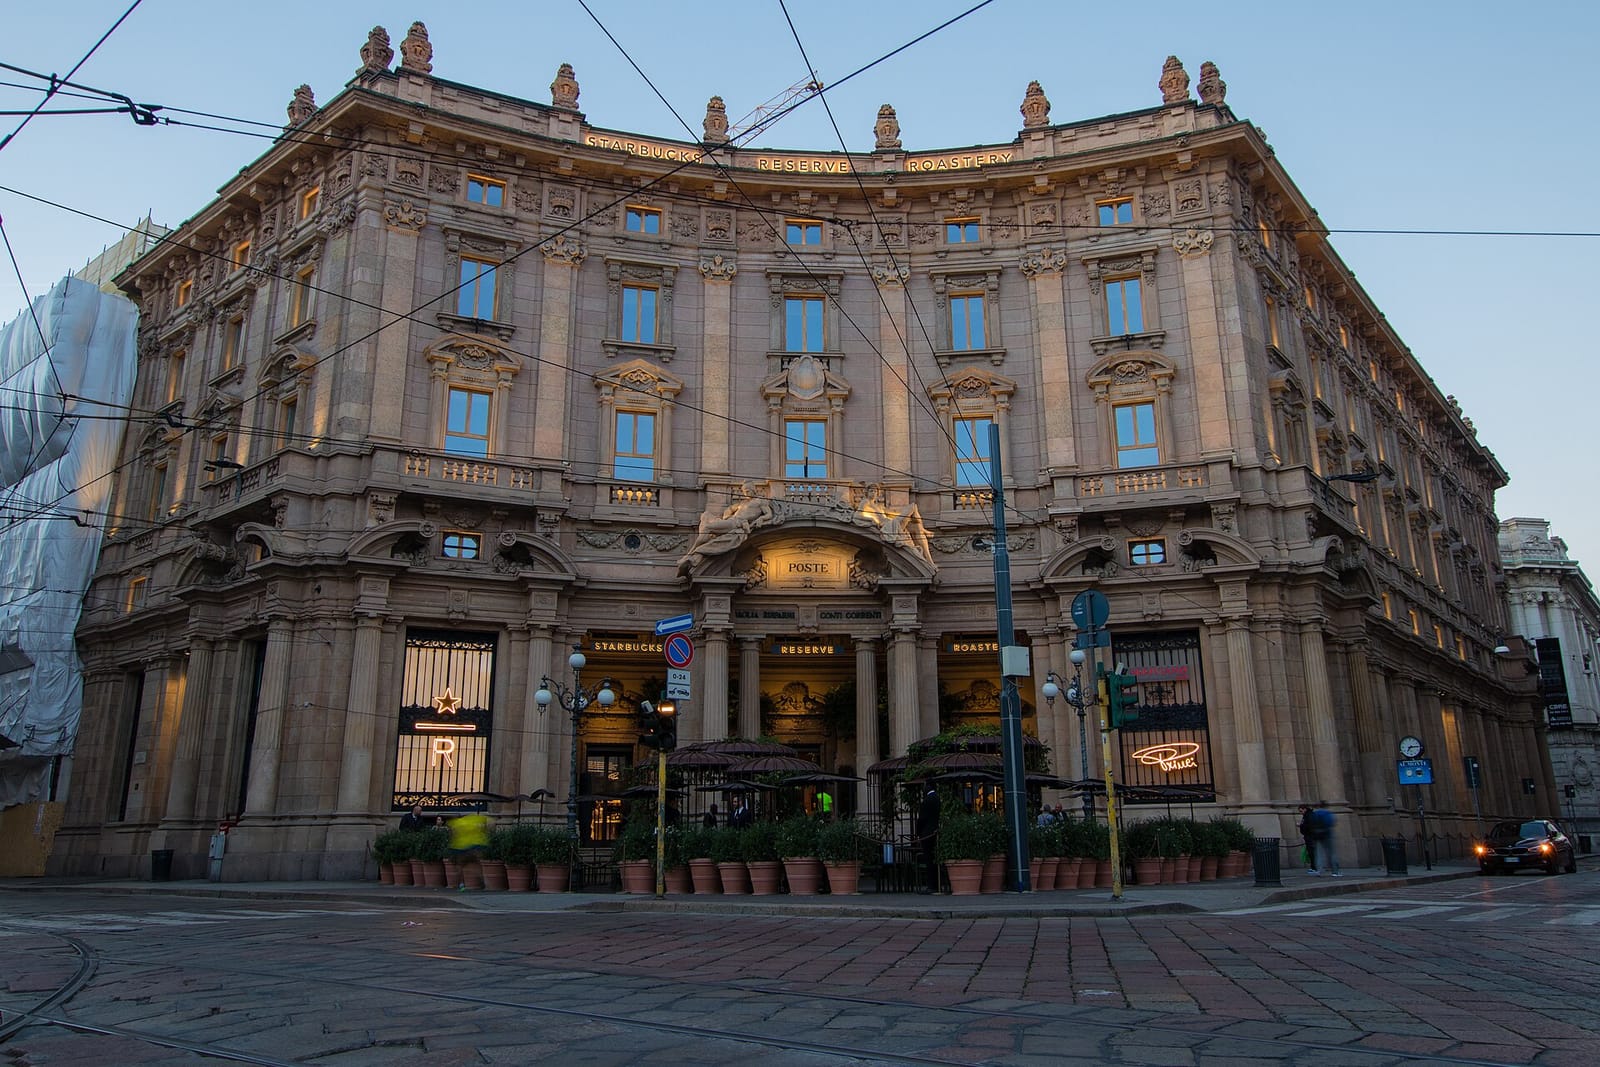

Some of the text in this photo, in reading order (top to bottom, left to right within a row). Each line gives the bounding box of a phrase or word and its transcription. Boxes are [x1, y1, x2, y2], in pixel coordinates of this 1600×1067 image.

[588, 136, 1011, 172] STARBUCKS RESERVE ROASTERY
[788, 562, 829, 573] POSTE
[594, 641, 663, 653] STARBUCKS
[781, 644, 835, 654] RESERVE
[953, 643, 999, 652] ROASTE
[431, 738, 455, 768] R
